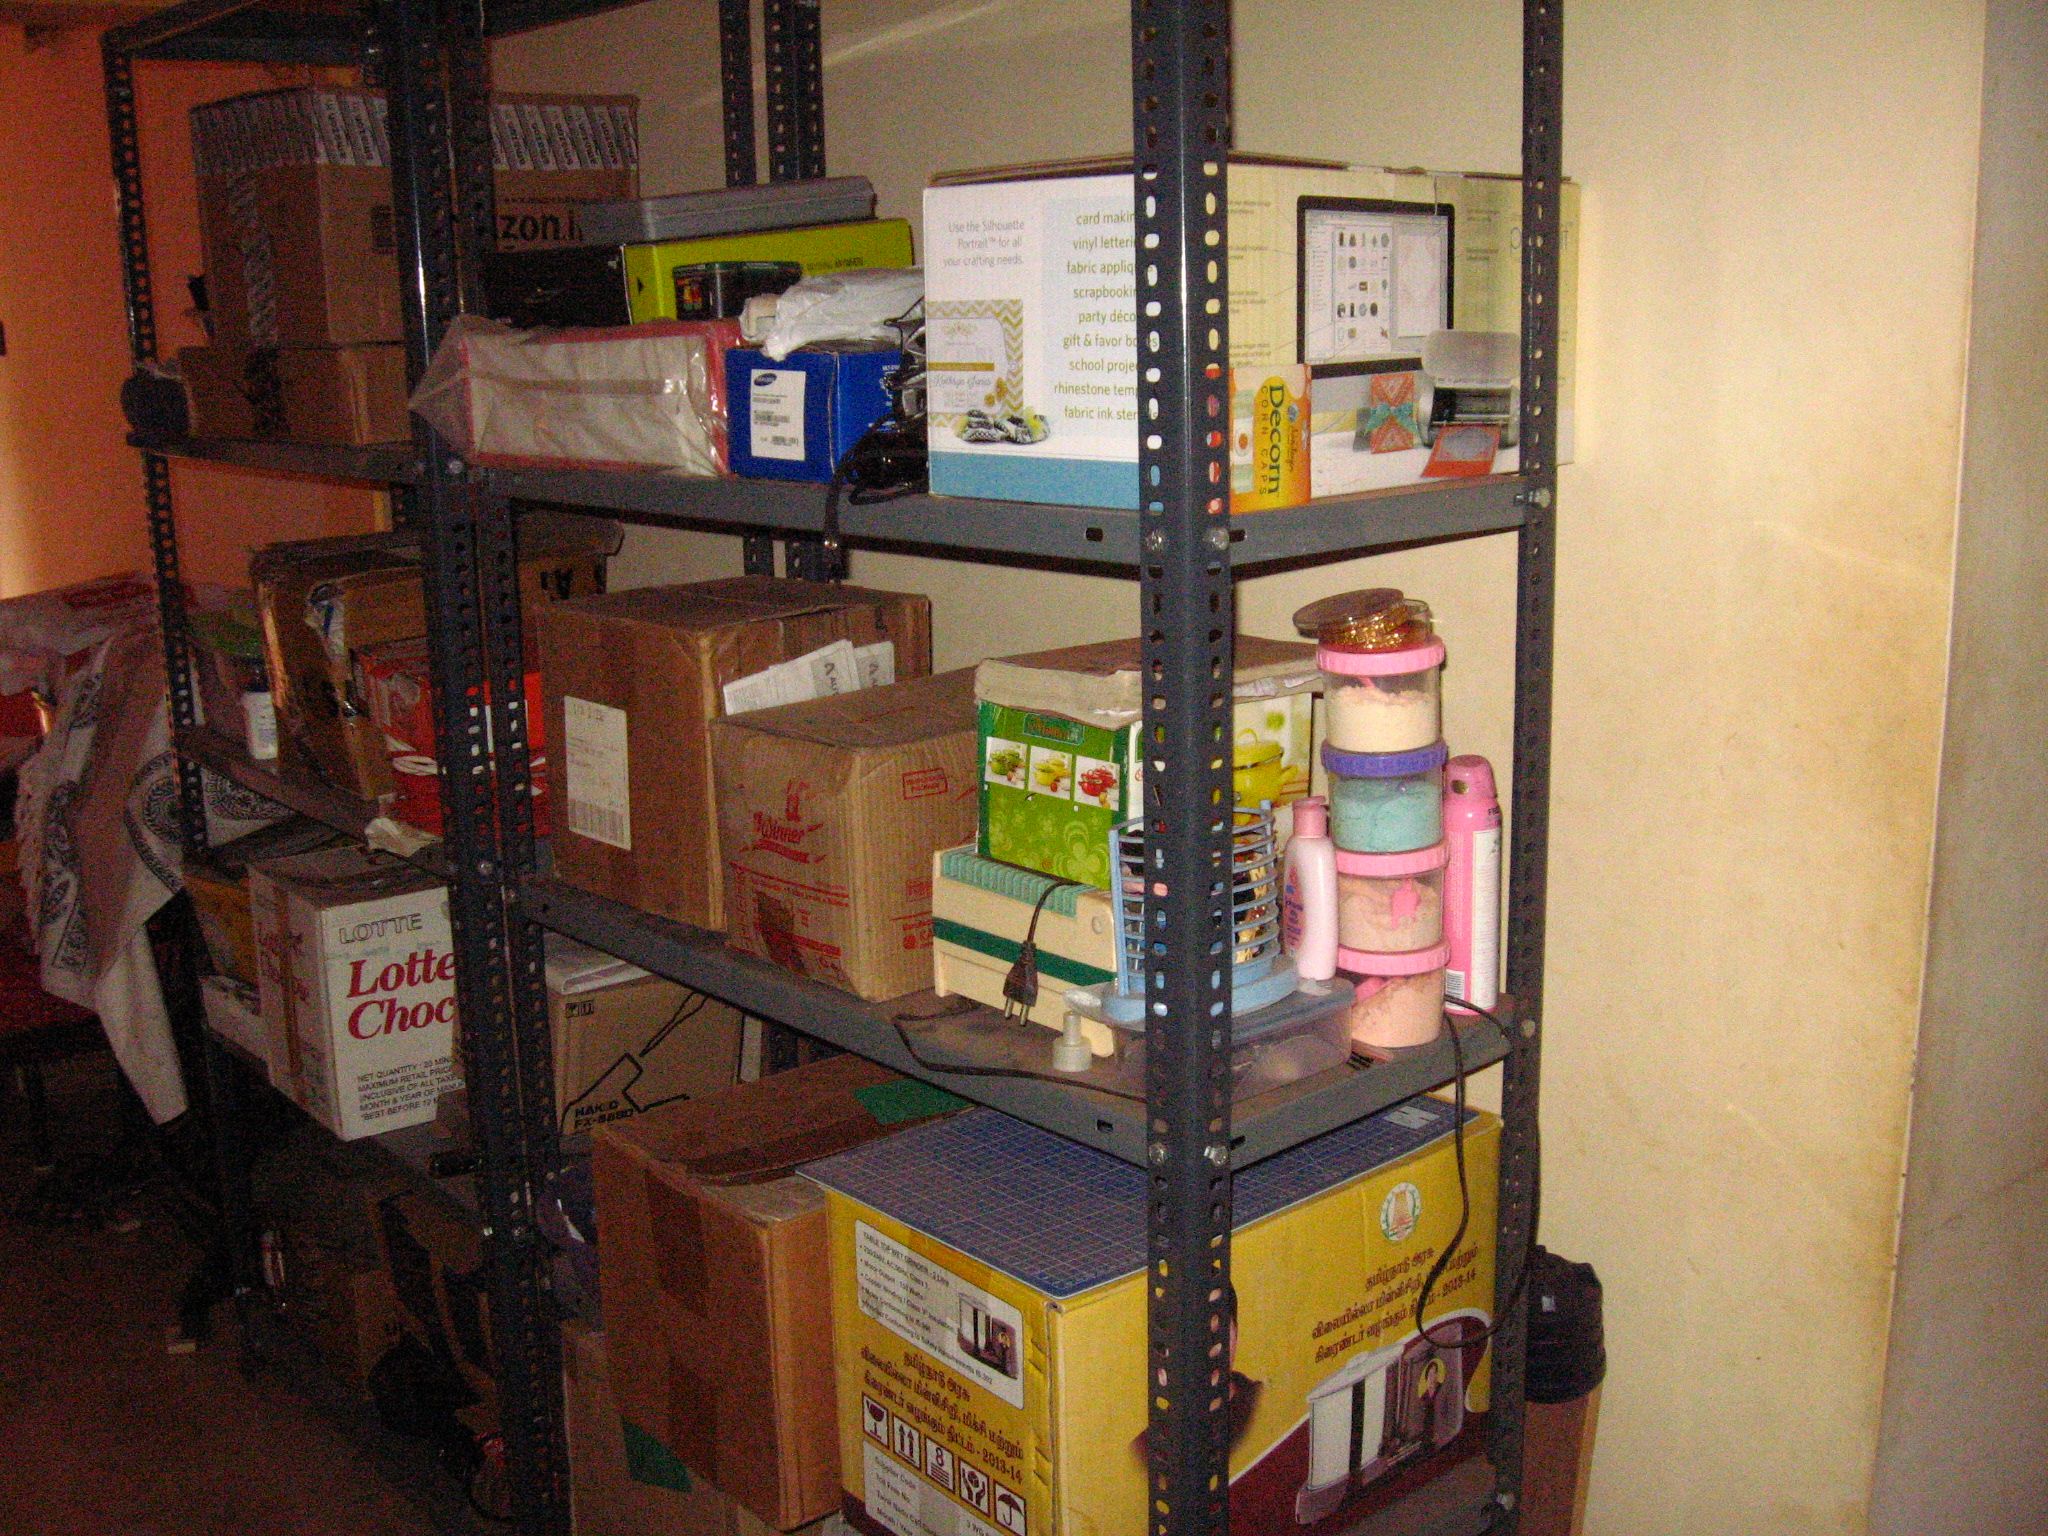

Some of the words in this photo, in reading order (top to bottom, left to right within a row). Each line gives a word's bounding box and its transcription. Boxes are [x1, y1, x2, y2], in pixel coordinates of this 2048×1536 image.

[948, 221, 964, 233] Use
[966, 220, 980, 232] the
[1076, 211, 1100, 225] card
[998, 234, 1010, 248] for
[1012, 234, 1023, 248] all
[1072, 236, 1098, 252] vinyl
[943, 257, 961, 268] your
[1066, 260, 1096, 274] fabric
[1078, 310, 1107, 325] party
[1063, 332, 1080, 350] gift
[1083, 333, 1093, 347] &
[1095, 333, 1123, 347] favor
[1069, 359, 1104, 372] school
[1054, 382, 1110, 396] rhinestone
[1064, 405, 1094, 419] fabric
[1097, 406, 1112, 420] ink
[1260, 385, 1269, 435] CORN
[1268, 385, 1285, 495] Decorn
[1259, 448, 1268, 495] CAPS
[339, 913, 423, 945] LOTTE
[346, 948, 456, 998] Lotte
[357, 1072, 374, 1083] NET
[376, 1064, 417, 1079] QUANTITY
[358, 1077, 399, 1092] MAXIMUM
[400, 1071, 428, 1083] RETAIL
[359, 1085, 405, 1101] INCLUSIVE
[406, 1082, 418, 1091] OF
[420, 1080, 434, 1088] ALL
[360, 1098, 390, 1111] MONTH
[400, 1091, 422, 1102] YEAR
[423, 1088, 435, 1097] OF
[387, 1102, 420, 1115] BEFORE
[982, 1448, 1023, 1485] 2013-14
